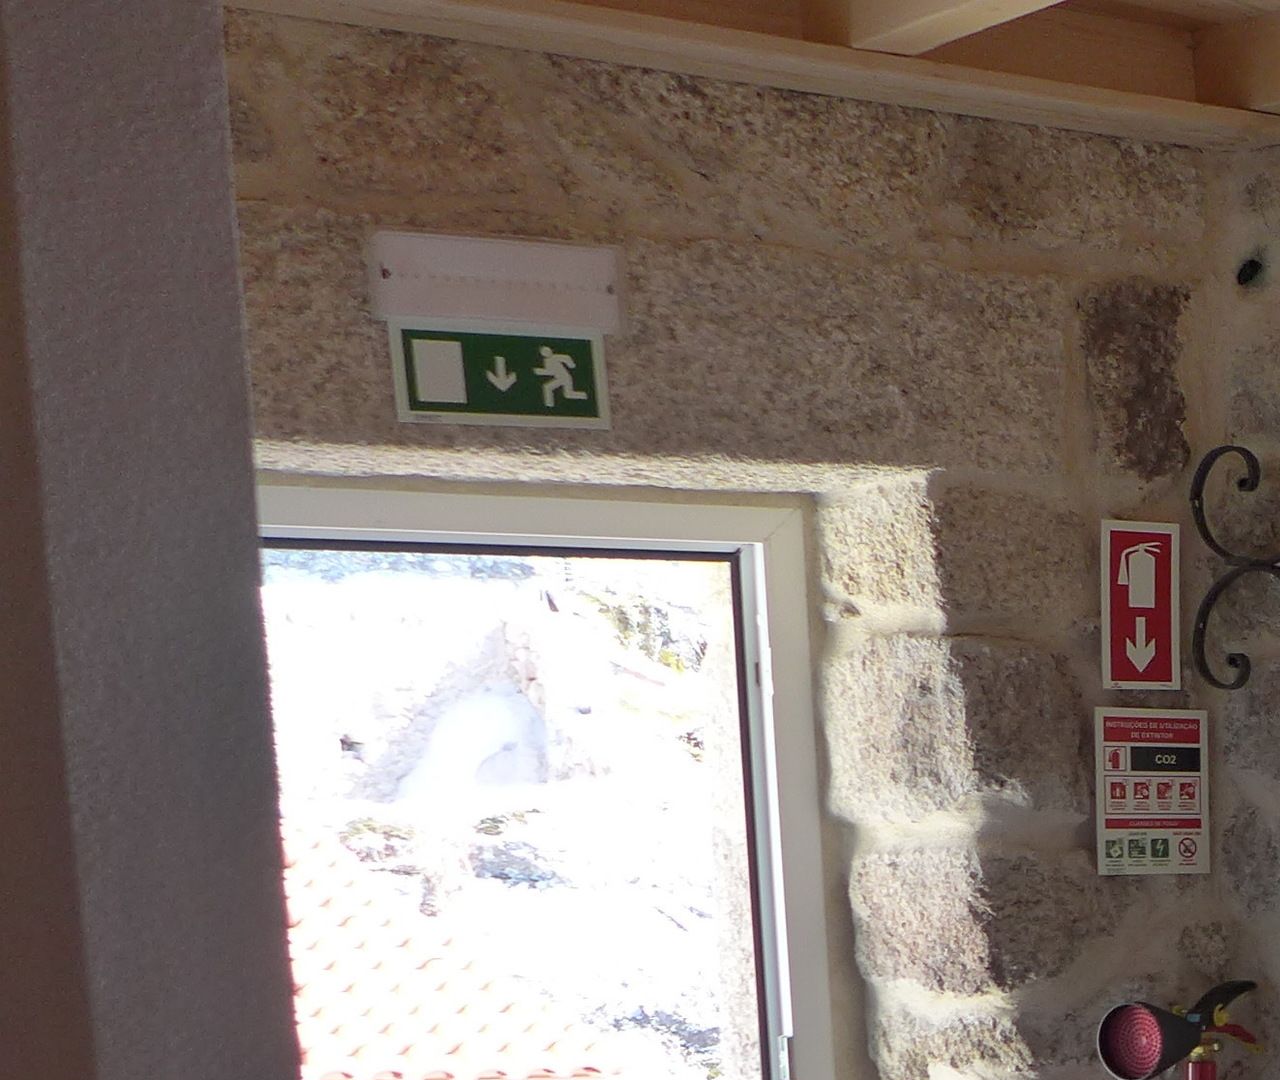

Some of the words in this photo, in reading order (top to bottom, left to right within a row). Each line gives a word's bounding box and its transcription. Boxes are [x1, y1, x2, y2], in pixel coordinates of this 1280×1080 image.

[1105, 720, 1149, 729] INSTRUÇÕES
[1149, 721, 1158, 729] DE
[1159, 721, 1198, 730] UTILIZAÇÃO
[1155, 754, 1177, 765] CO2
